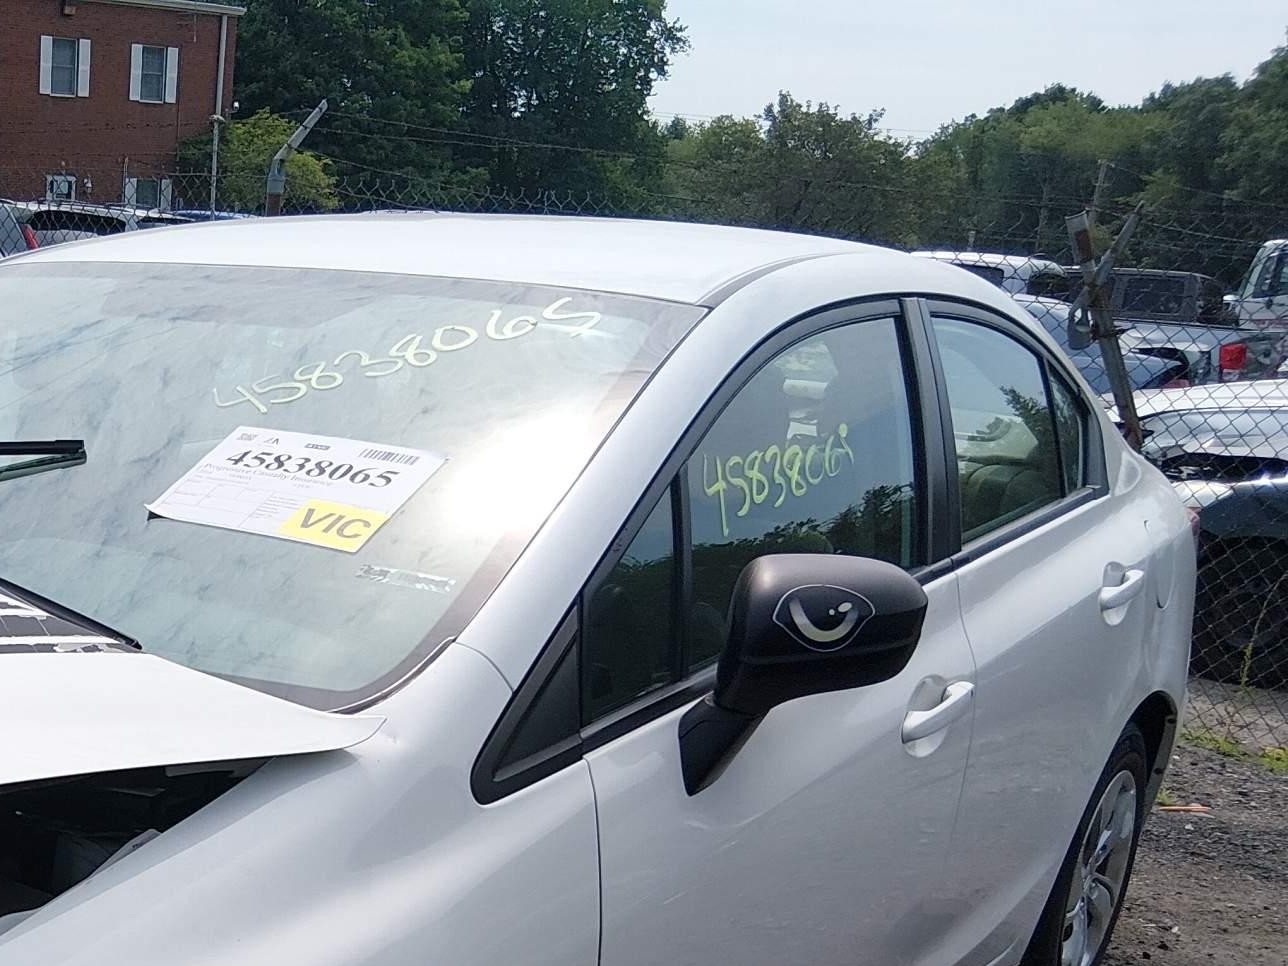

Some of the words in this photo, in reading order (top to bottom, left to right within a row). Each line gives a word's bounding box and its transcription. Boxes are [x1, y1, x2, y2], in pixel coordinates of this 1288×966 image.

[214, 296, 602, 415] 45838065
[225, 448, 401, 488] 45838065
[299, 507, 372, 540] VIC
